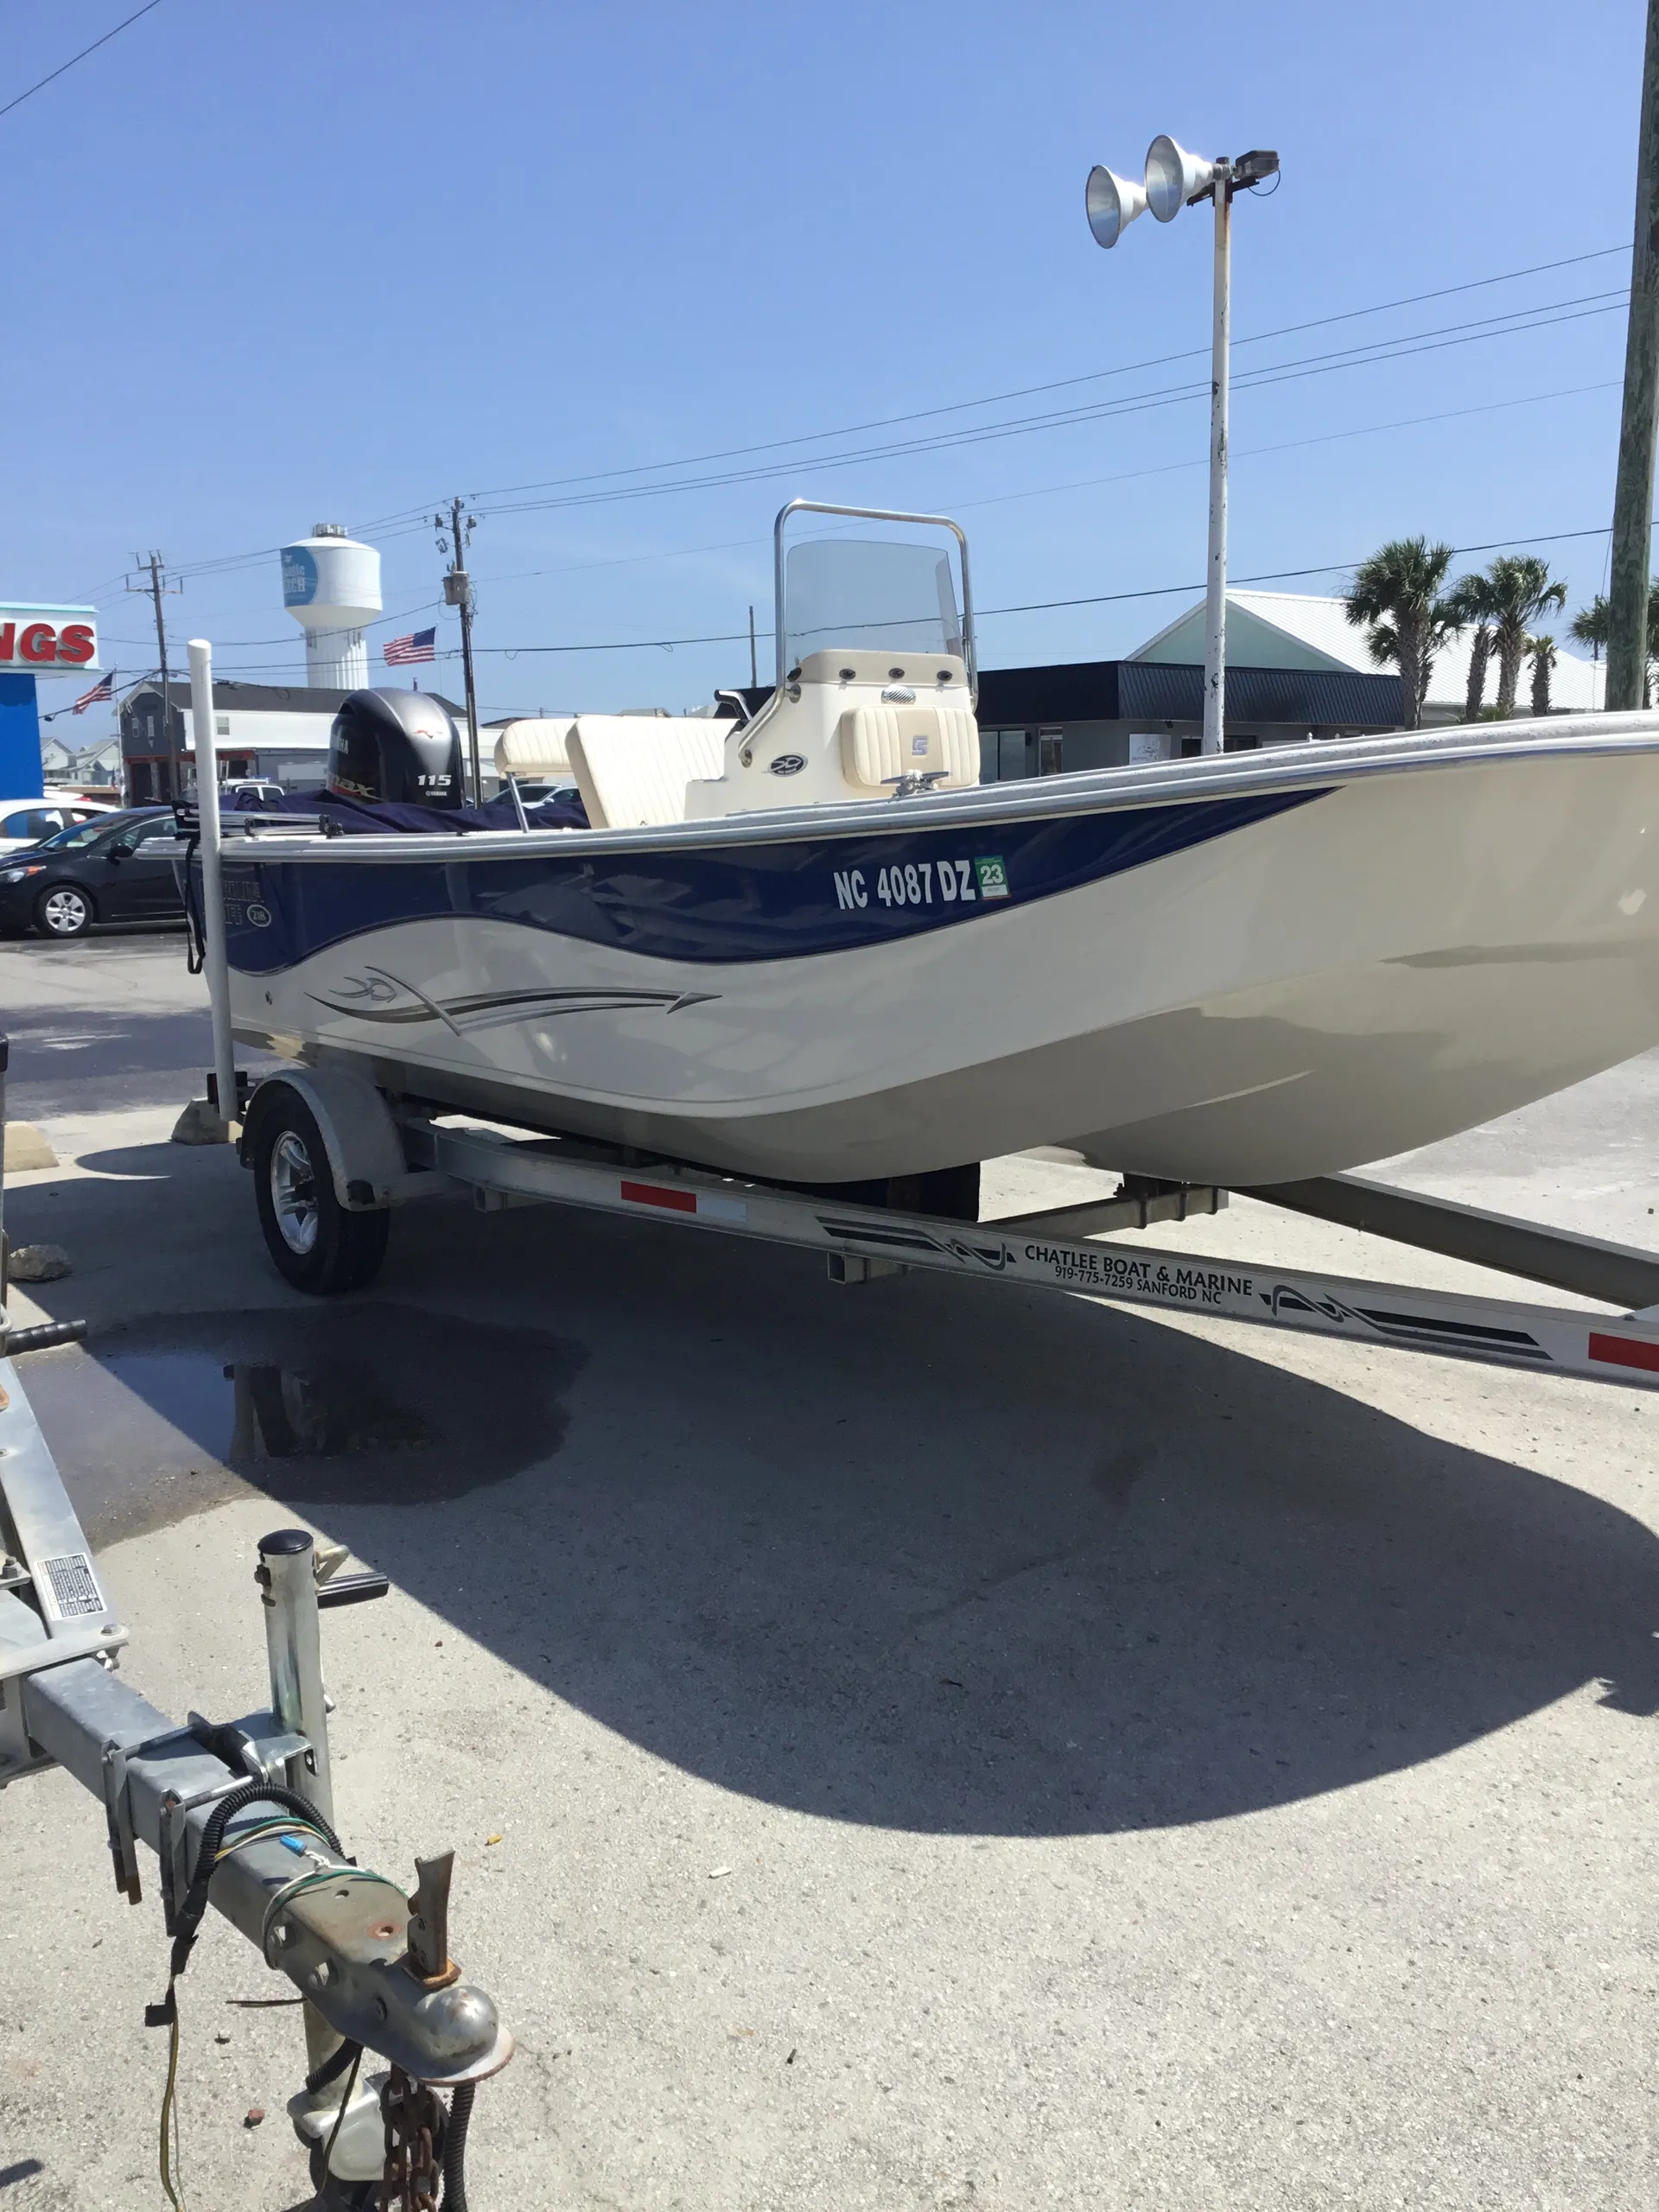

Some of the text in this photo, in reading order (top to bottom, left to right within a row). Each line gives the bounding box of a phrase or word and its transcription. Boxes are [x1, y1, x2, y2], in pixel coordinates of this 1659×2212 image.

[417, 774, 452, 785] 115
[833, 860, 976, 910] NC 4087 DZ
[980, 864, 1003, 885] 23
[1025, 1244, 1253, 1296] CHATLEE BOAT & MARINE
[1055, 1265, 1222, 1305] 919-775-7259 SANFORD NC
